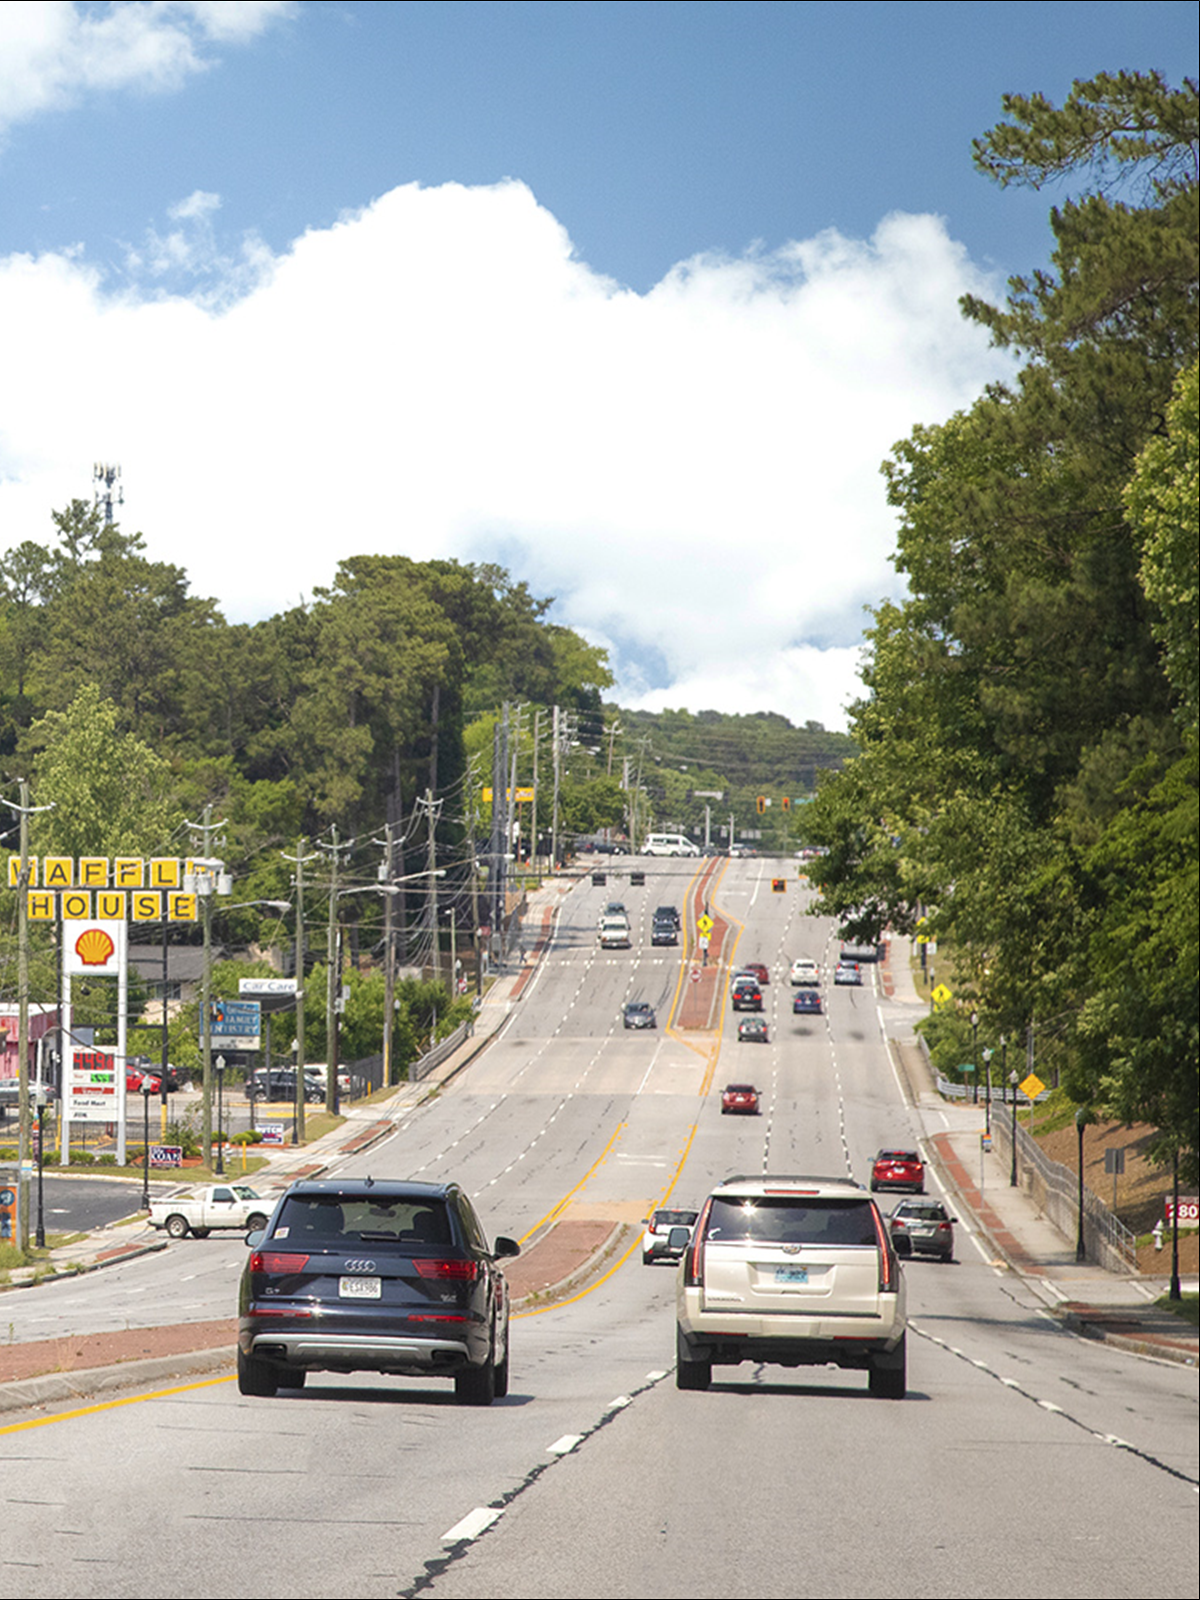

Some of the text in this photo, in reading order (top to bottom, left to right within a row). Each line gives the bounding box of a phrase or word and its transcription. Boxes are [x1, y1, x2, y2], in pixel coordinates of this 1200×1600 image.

[13, 862, 205, 883] WAFFL
[31, 896, 190, 917] HOUSE
[243, 982, 295, 991] Car Care
